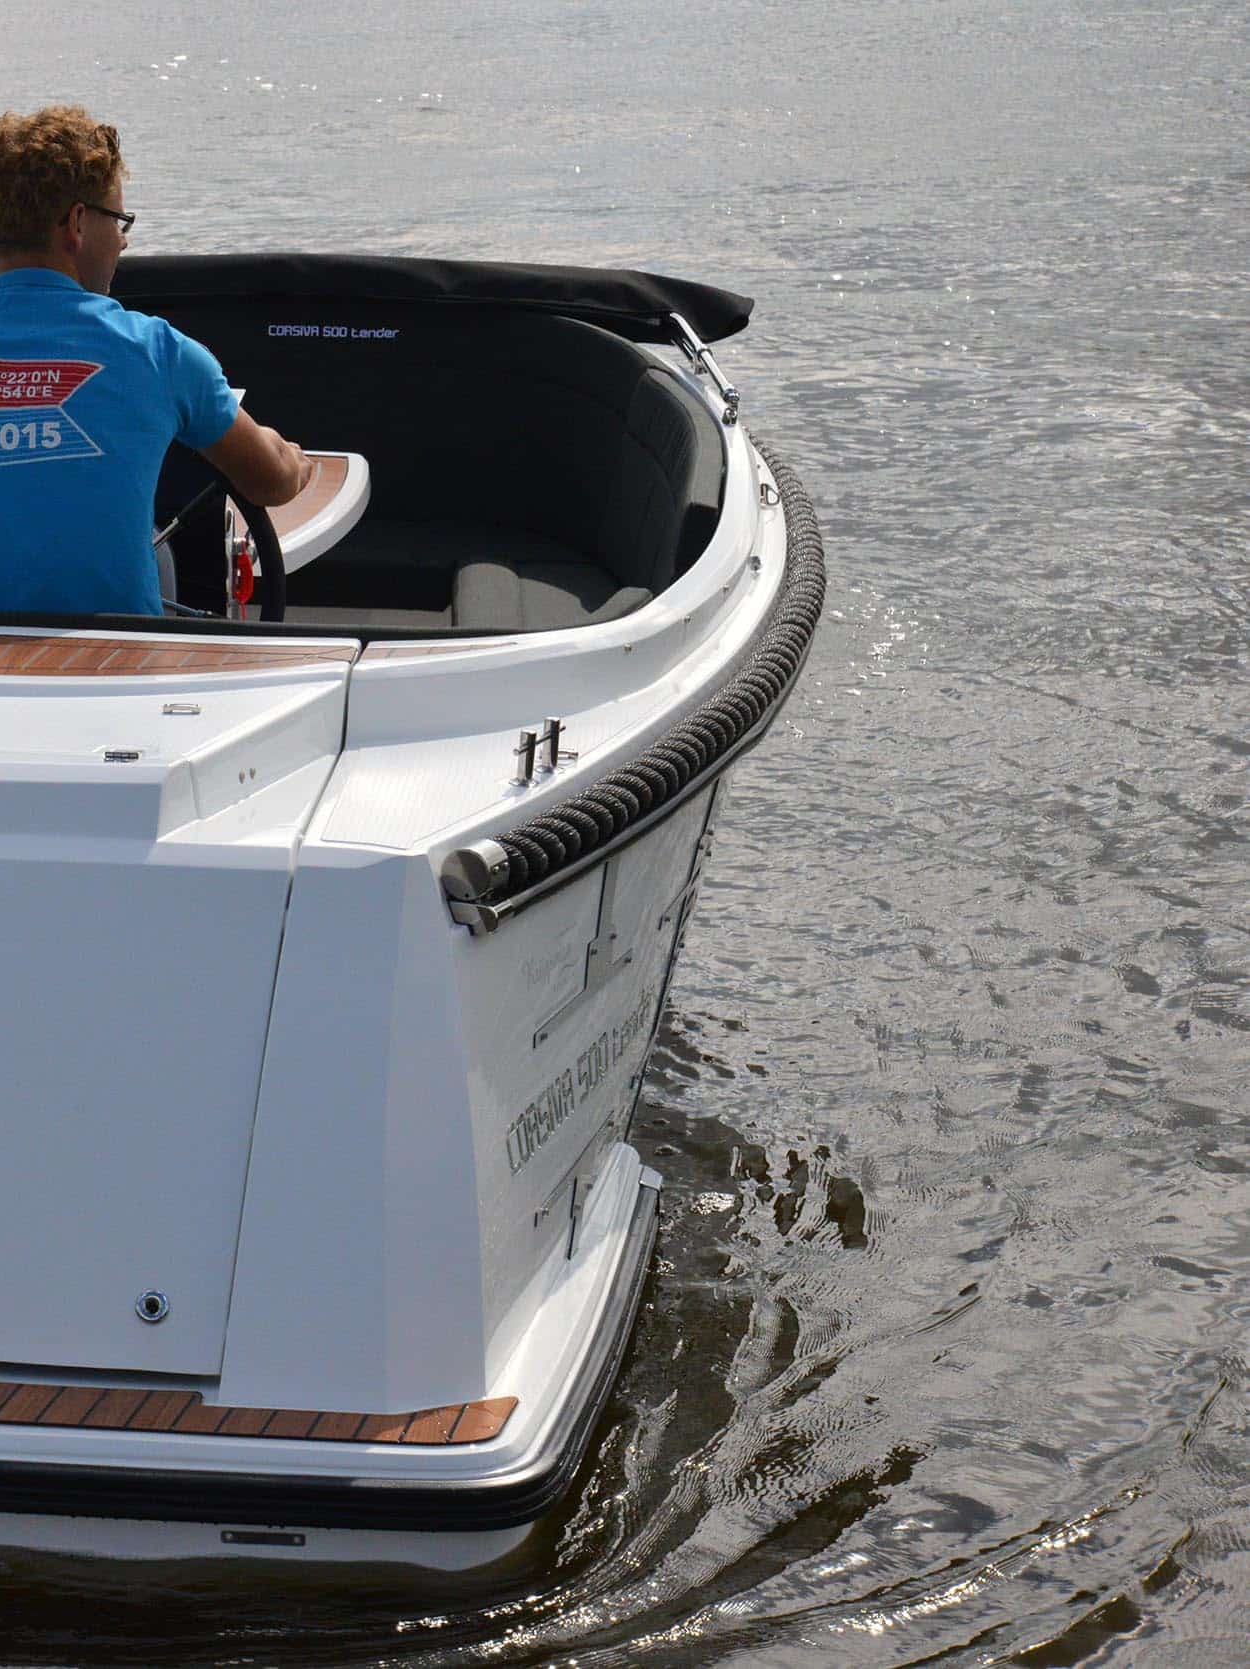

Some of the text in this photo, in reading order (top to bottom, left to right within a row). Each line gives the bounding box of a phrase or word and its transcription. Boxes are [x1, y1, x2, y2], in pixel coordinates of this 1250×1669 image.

[268, 325, 400, 339] CORSIVA 500 tender
[507, 1068, 575, 1177] CORSIVA
[577, 1031, 609, 1104] 500
